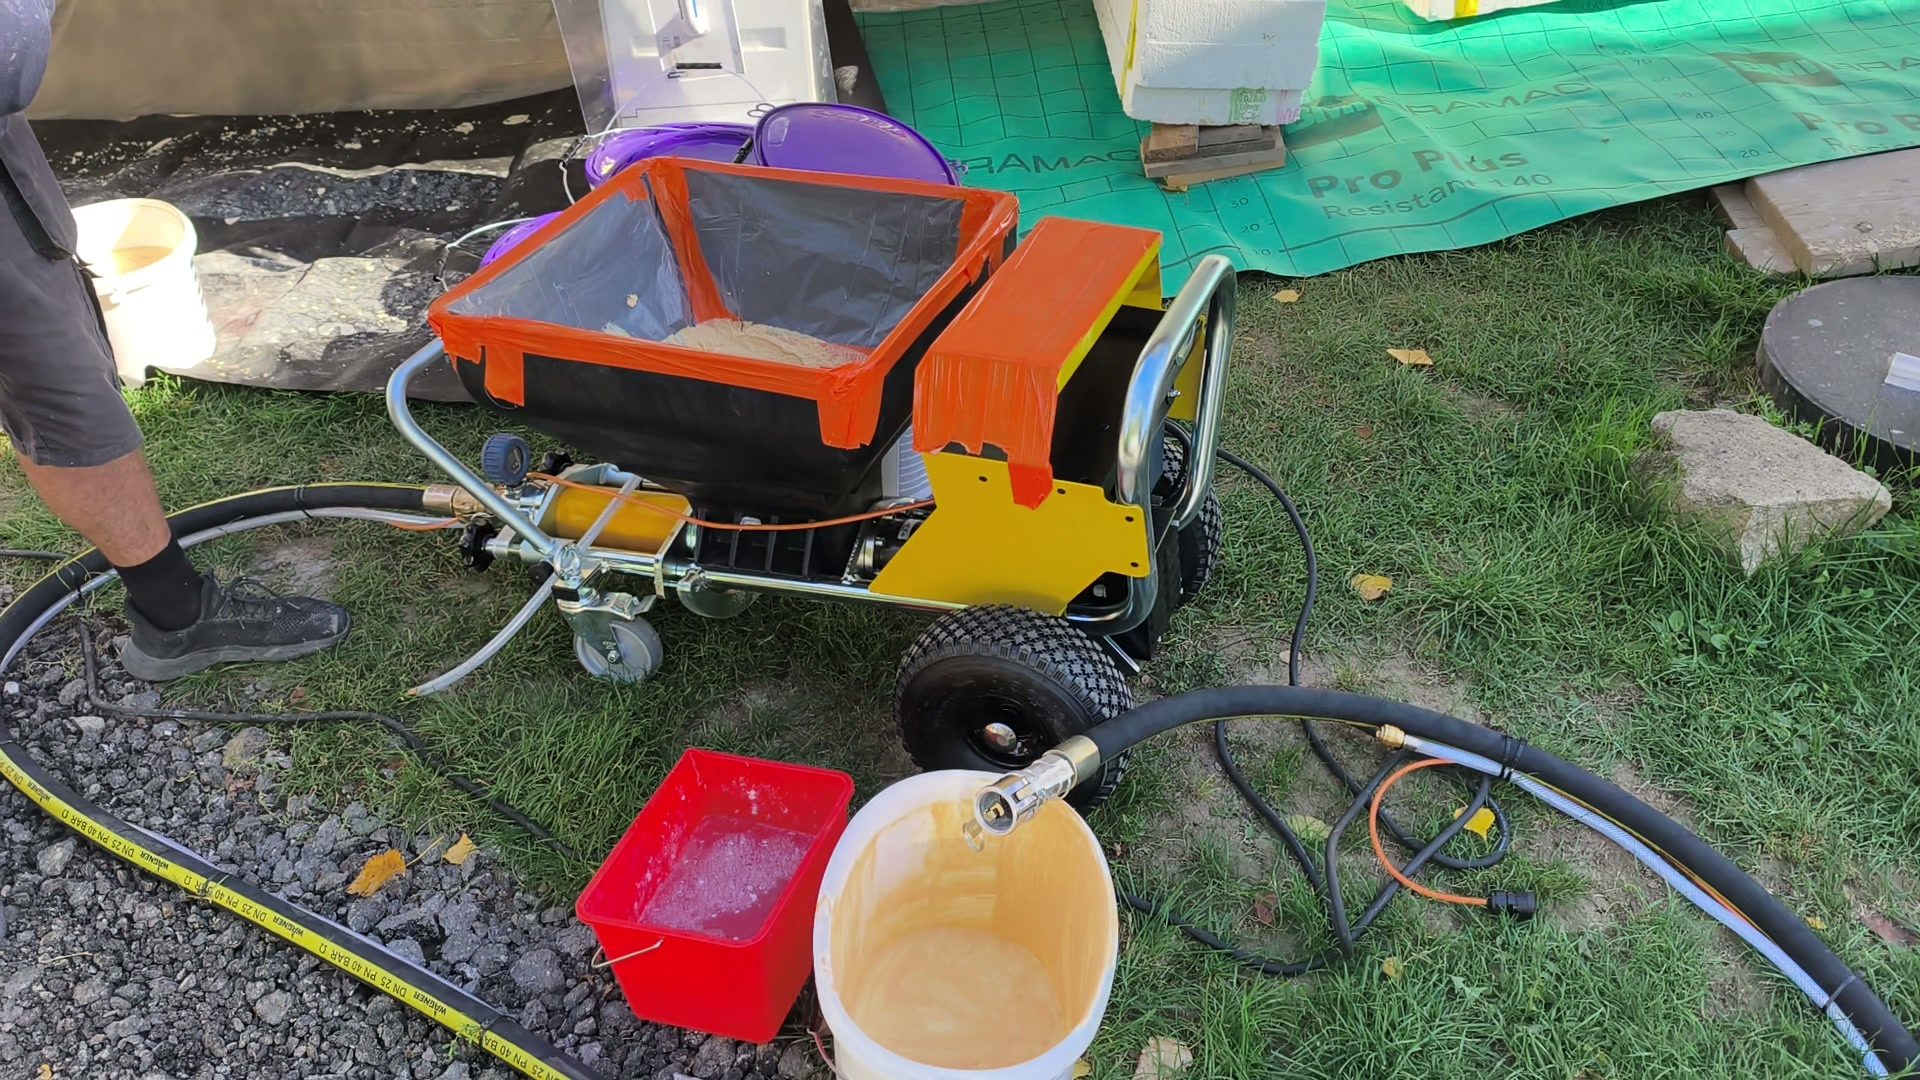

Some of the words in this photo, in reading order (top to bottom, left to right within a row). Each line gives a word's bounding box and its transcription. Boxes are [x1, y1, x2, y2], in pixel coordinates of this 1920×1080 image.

[1696, 111, 1714, 119] 40
[1740, 149, 1760, 158] 20
[948, 149, 1140, 174] RAMAC
[1307, 169, 1402, 198] Pro
[1412, 149, 1529, 173] Plus
[1321, 178, 1477, 219] Resistant
[1489, 174, 1553, 188] 140
[70, 815, 87, 831] BAR
[87, 825, 97, 837] 40
[96, 831, 110, 843] PN
[111, 839, 122, 851] 25
[121, 844, 135, 858] DN
[140, 850, 169, 872] WAGNER
[194, 880, 213, 897] BR
[214, 890, 225, 901] 40
[225, 895, 239, 908] PN
[242, 903, 253, 915] 25
[253, 909, 267, 922] DN
[273, 915, 304, 938] WAGNER
[330, 950, 350, 967] BAR
[351, 960, 363, 972] 40
[363, 967, 378, 981] PN
[380, 976, 392, 989] 25
[393, 983, 407, 998] DN
[413, 991, 447, 1016] WAGNER
[500, 1045, 512, 1058] 40
[513, 1053, 528, 1068] PN
[531, 1064, 544, 1078] 25
